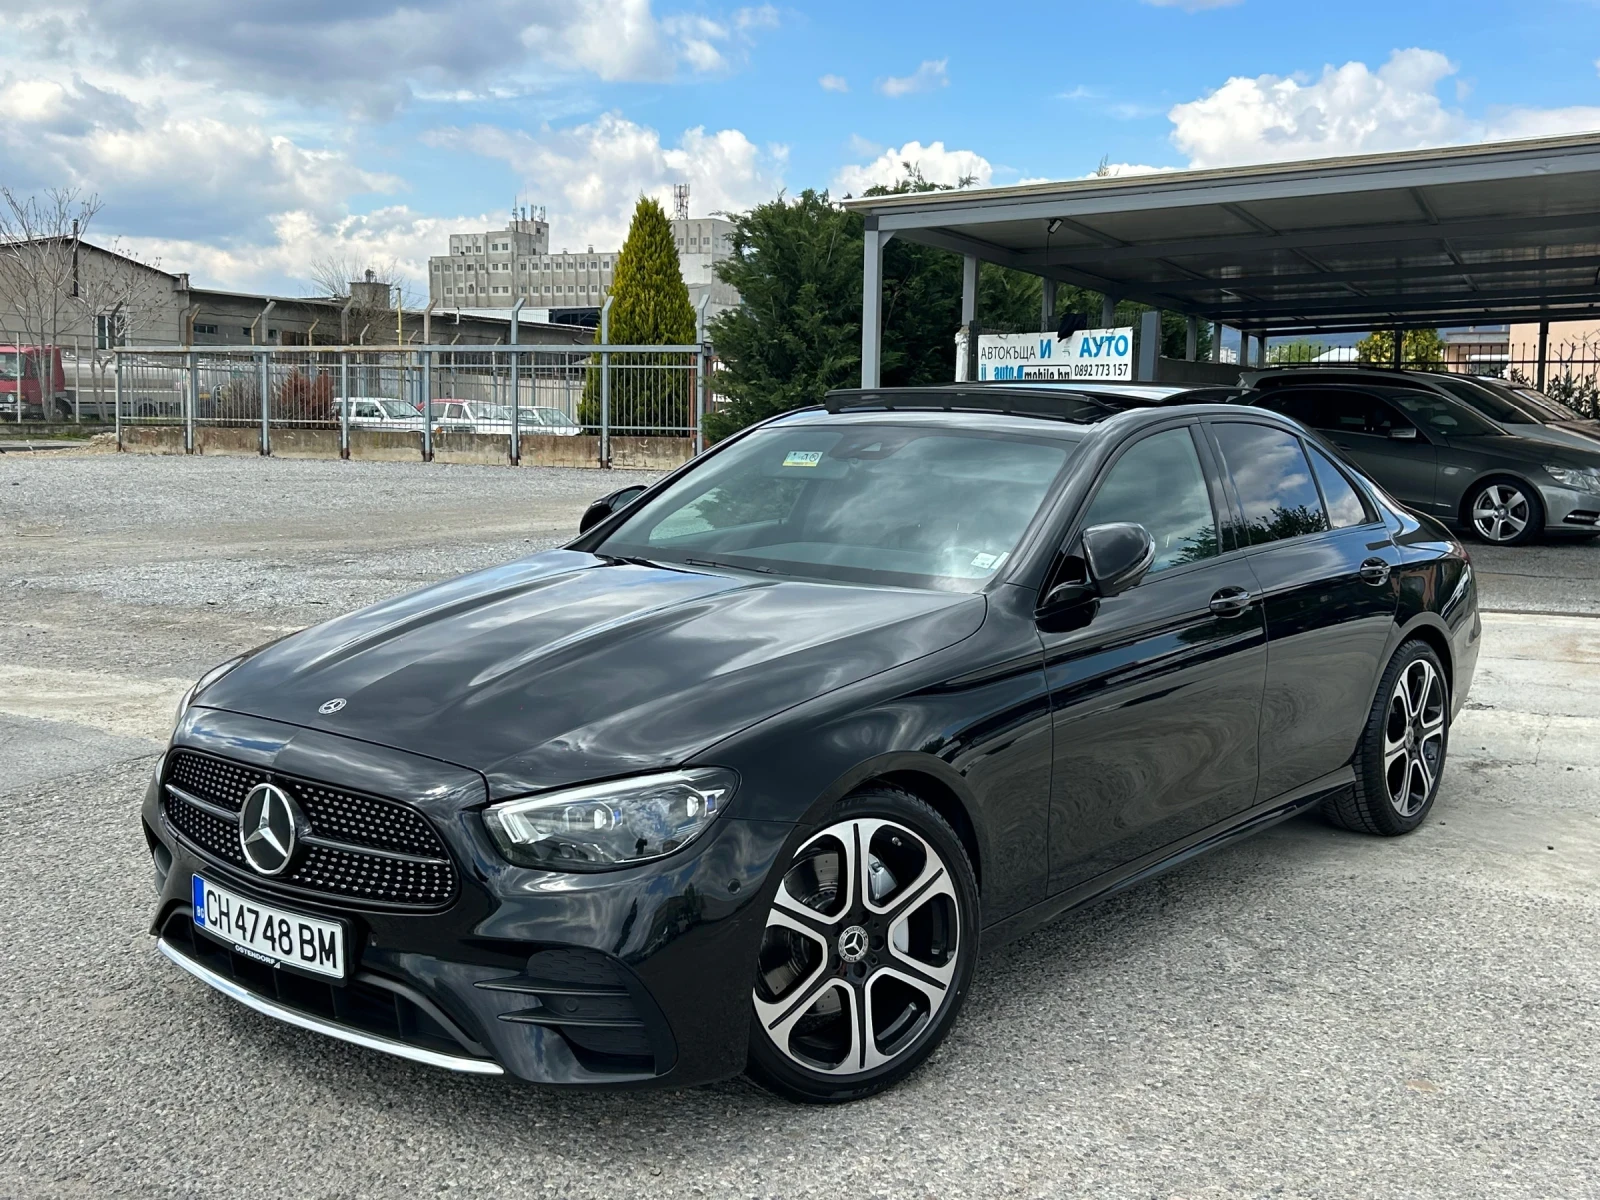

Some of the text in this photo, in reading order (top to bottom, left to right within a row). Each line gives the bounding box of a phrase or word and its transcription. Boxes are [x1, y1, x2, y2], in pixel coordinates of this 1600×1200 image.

[981, 345, 1036, 362] АВТОКЪЩА
[1079, 334, 1129, 358] АУТО
[1074, 363, 1129, 377] 0892 773 157
[234, 944, 276, 965] OSTENDORF
